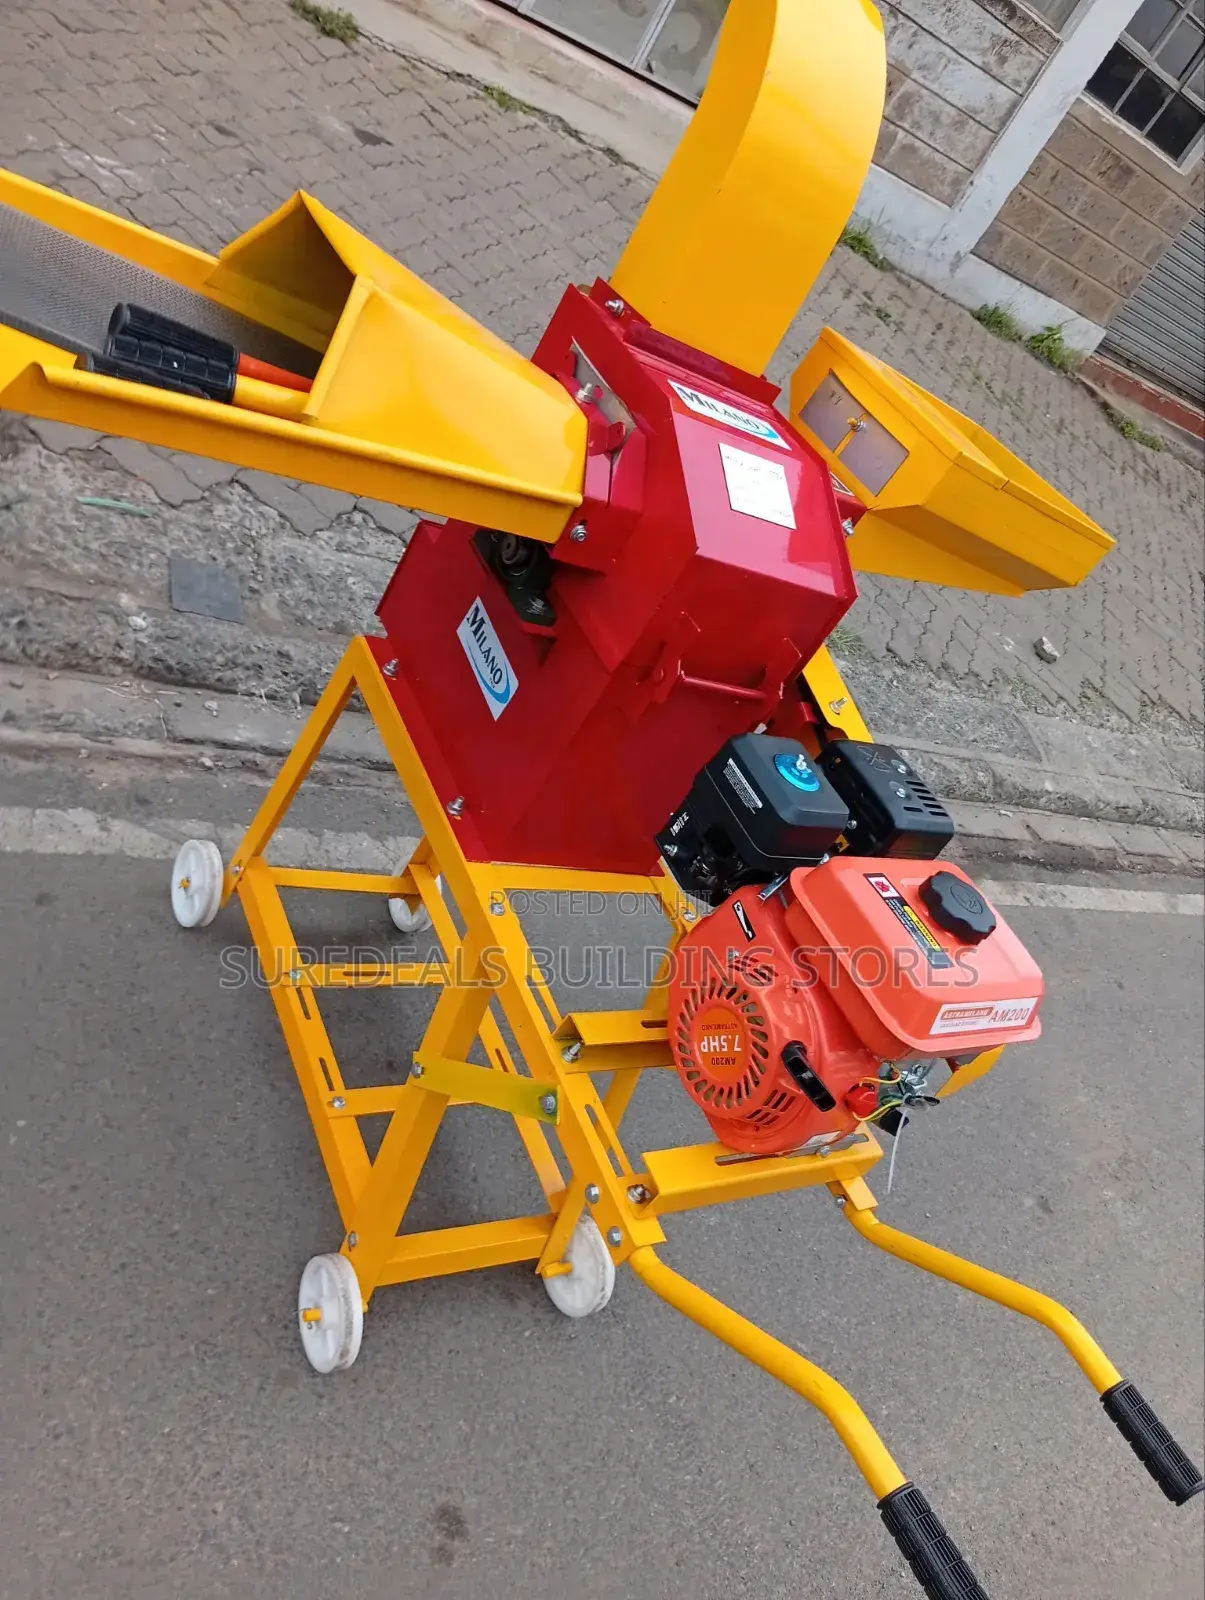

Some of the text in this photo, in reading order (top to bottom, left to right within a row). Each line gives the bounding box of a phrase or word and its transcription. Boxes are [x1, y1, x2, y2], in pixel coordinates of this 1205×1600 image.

[466, 603, 503, 685] MILANO
[987, 1008, 1030, 1023] AM200
[700, 1035, 742, 1052] 7.5HP
[711, 1057, 736, 1066] AM200
